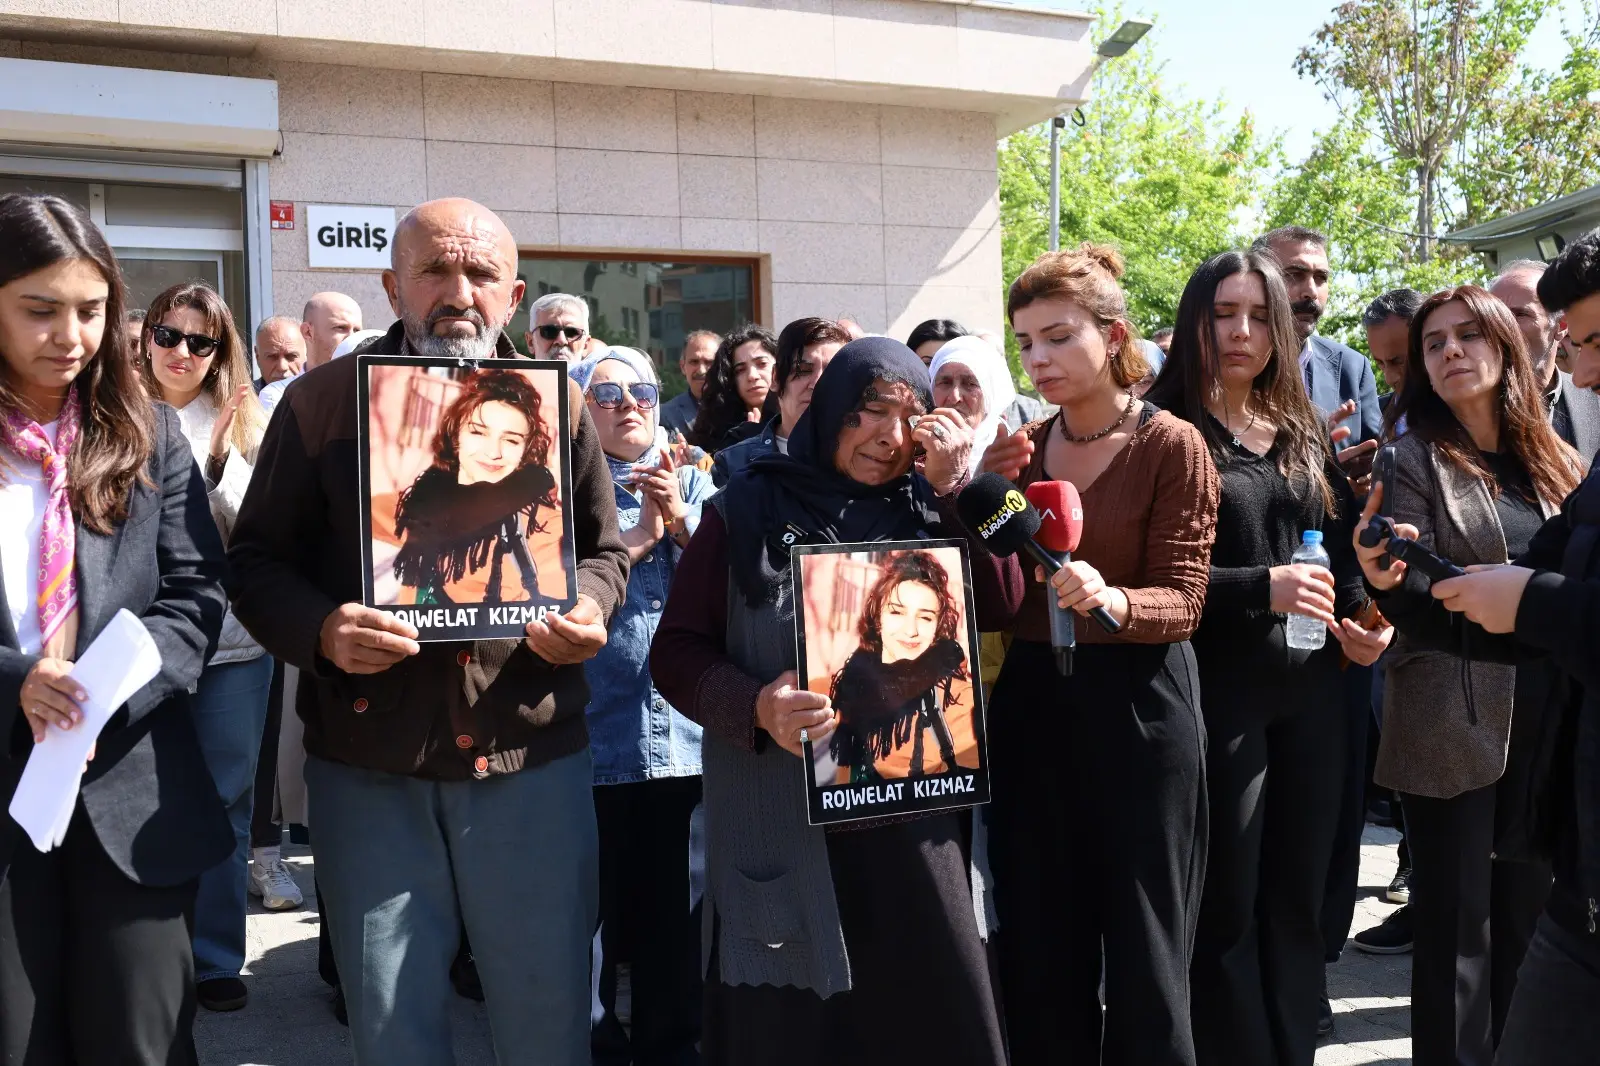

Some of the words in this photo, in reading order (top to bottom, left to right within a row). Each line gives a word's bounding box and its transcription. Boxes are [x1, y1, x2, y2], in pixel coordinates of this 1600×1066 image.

[279, 209, 285, 219] 4
[317, 221, 388, 252] GİRİŞ
[977, 504, 1008, 532] BATMAN
[981, 508, 1014, 539] BURADA
[822, 783, 904, 810] ROJWELAT
[914, 775, 975, 798] KIZMAZ
